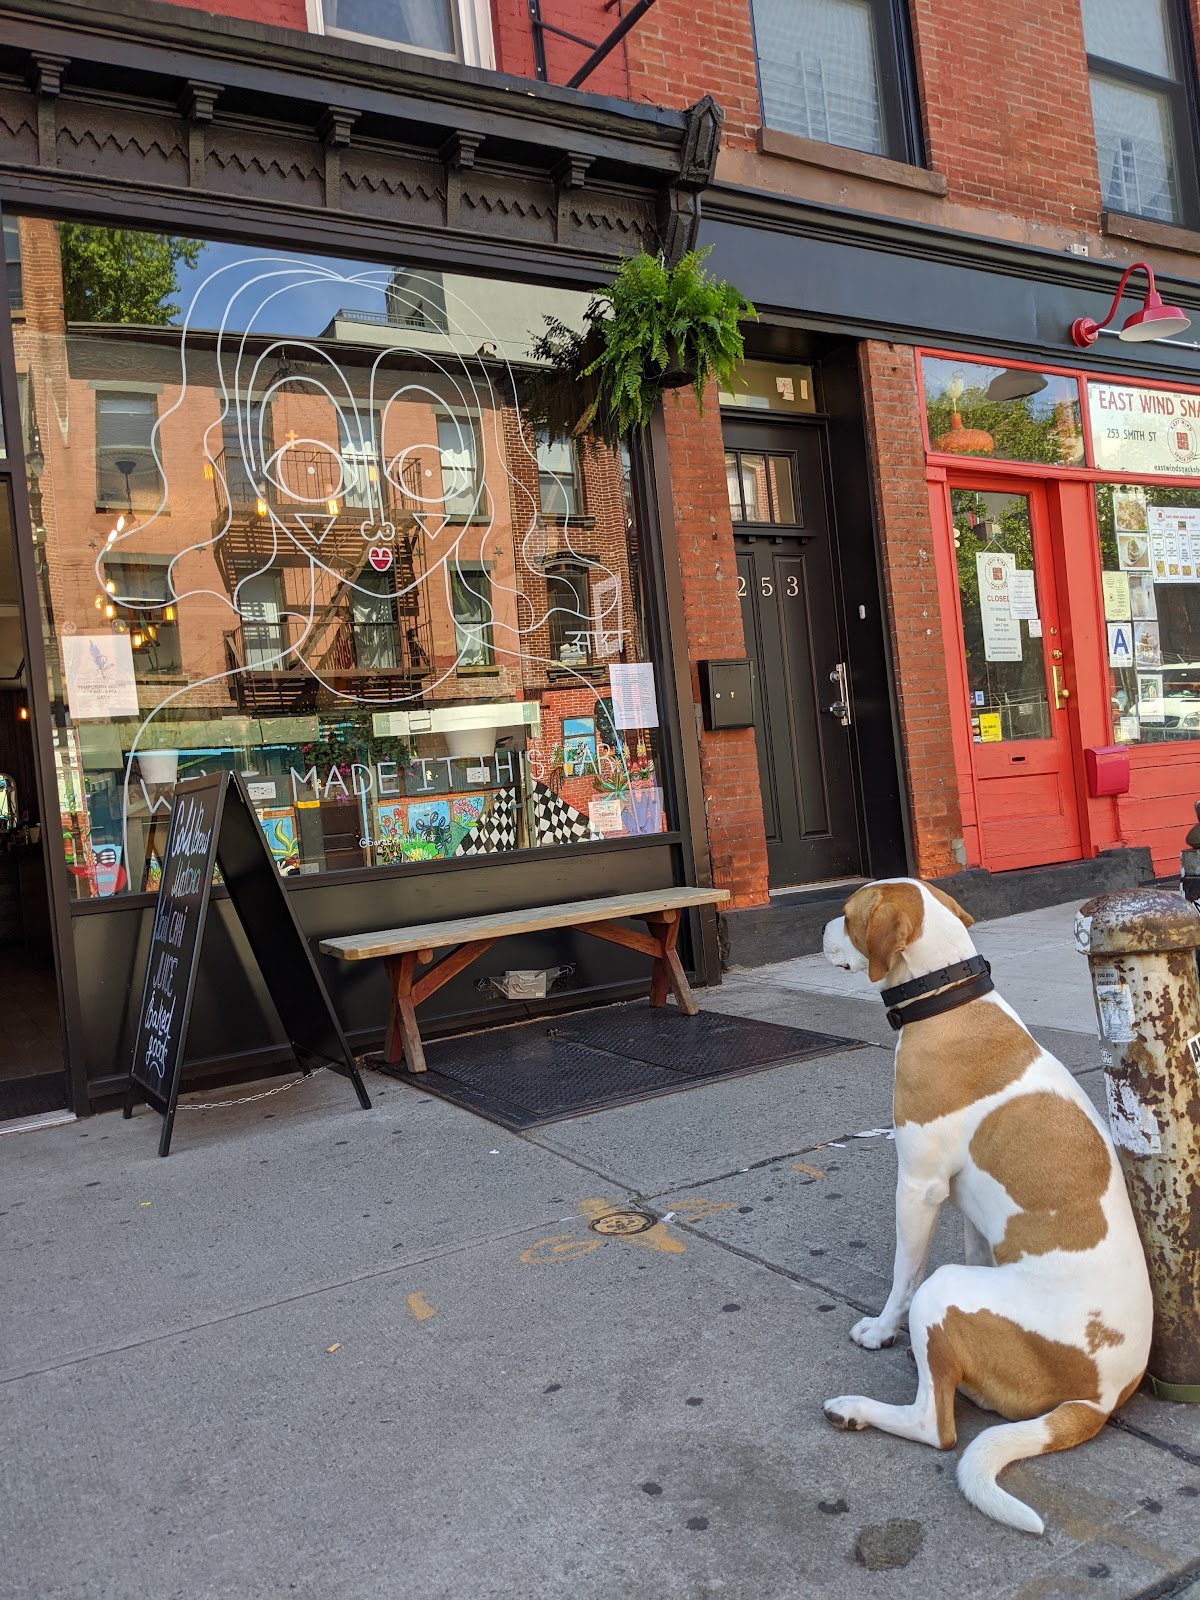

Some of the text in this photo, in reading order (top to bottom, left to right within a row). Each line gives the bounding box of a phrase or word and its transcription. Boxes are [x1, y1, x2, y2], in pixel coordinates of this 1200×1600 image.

[1098, 390, 1134, 412] EAST
[1139, 394, 1175, 416] WIND
[1106, 428, 1157, 442] 253 SMITH ST
[1113, 628, 1130, 655] A
[290, 762, 400, 803] MADE
[411, 756, 462, 792] IT
[563, 743, 618, 778] FAR
